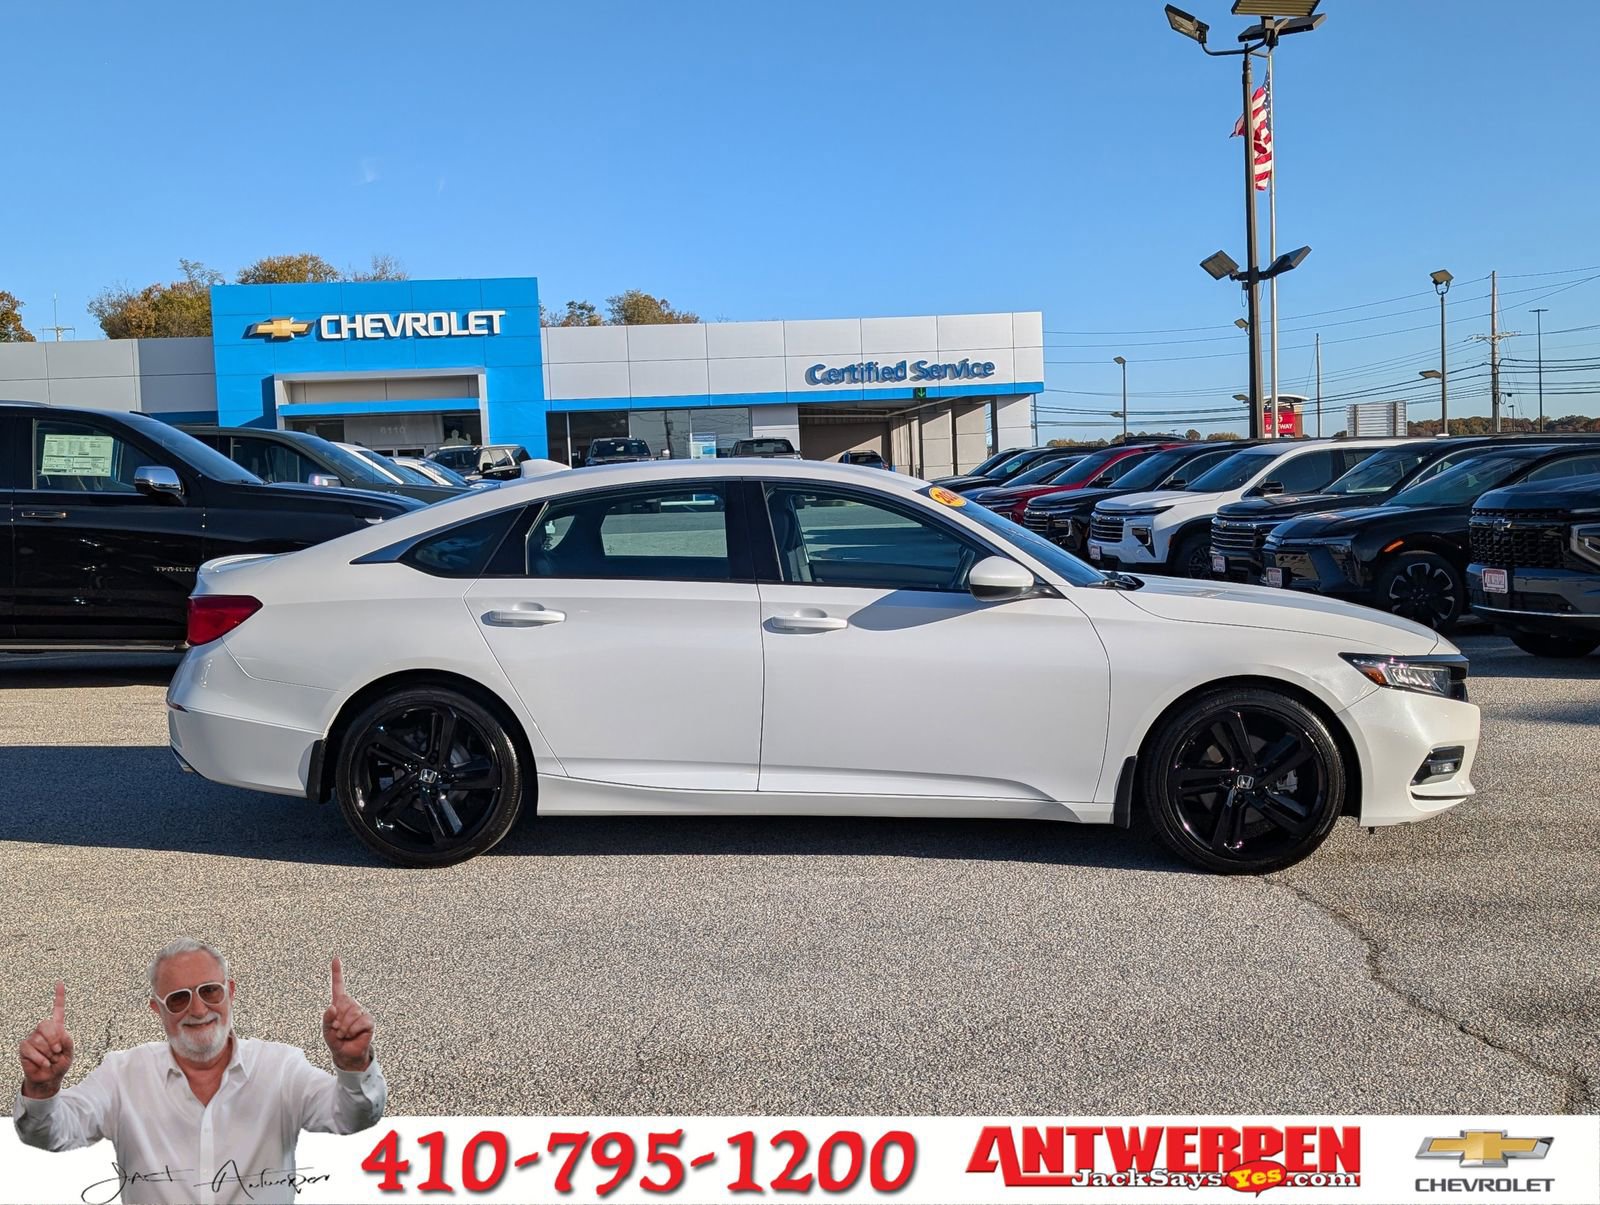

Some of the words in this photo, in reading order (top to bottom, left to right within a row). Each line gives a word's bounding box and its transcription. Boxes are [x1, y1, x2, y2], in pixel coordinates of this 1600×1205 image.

[320, 310, 506, 339] CHEVROLET
[805, 360, 908, 386] Certified
[909, 358, 996, 382] Service
